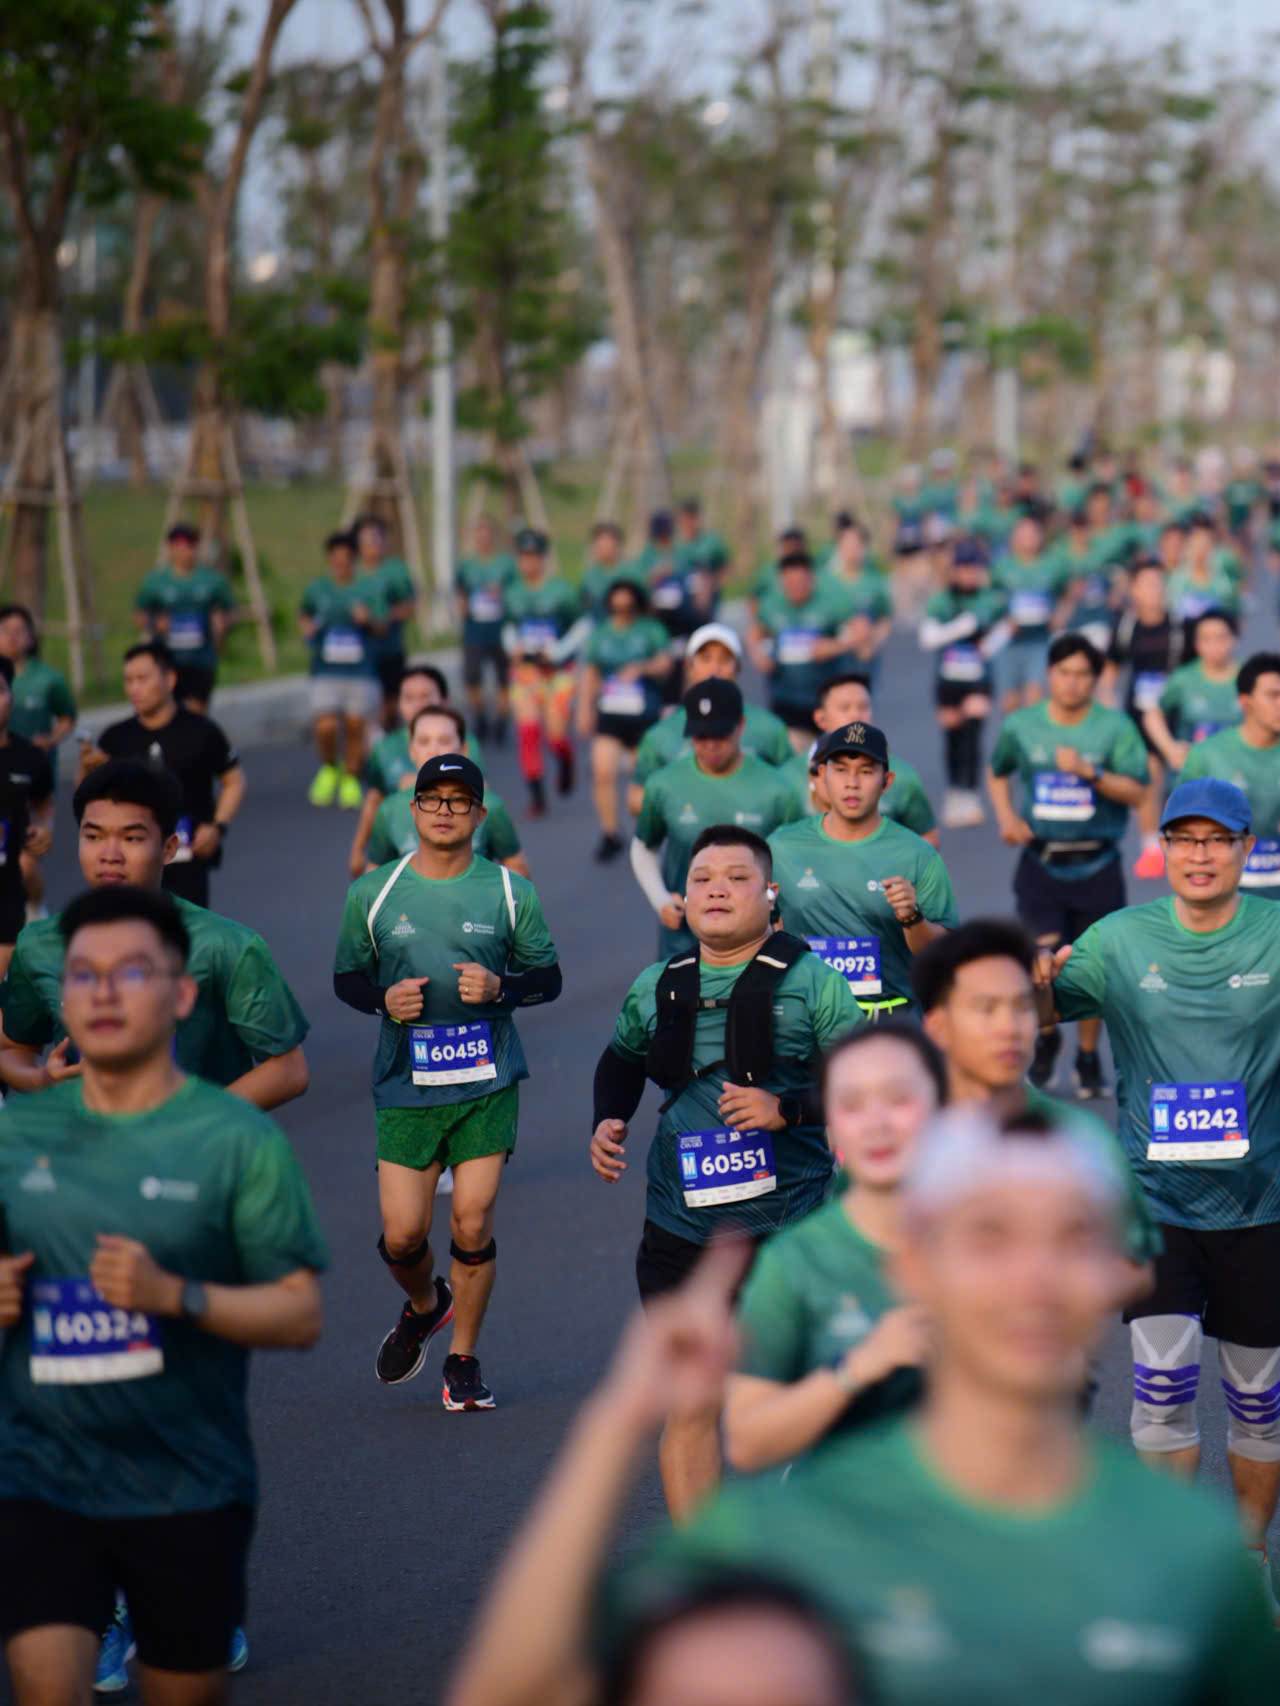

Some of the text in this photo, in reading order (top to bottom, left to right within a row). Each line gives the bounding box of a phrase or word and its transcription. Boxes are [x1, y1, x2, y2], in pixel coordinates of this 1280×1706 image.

[431, 1039, 489, 1062] 60458
[1174, 1107, 1239, 1131] 61242
[701, 1147, 767, 1176] 60551
[55, 1309, 150, 1345] 60324
